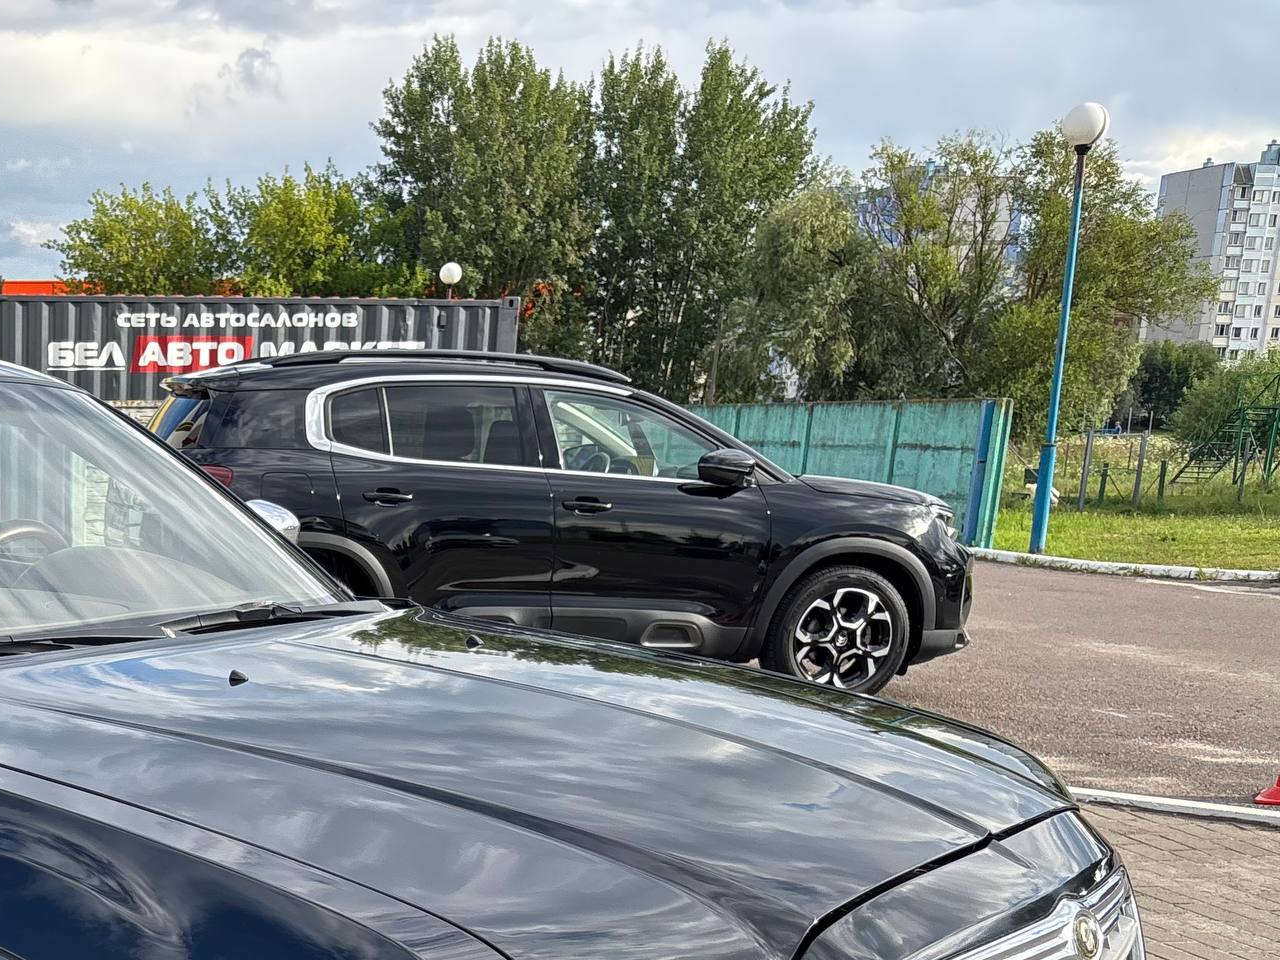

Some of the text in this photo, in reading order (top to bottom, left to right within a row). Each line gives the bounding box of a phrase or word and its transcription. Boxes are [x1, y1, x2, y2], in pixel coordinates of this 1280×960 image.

[116, 312, 359, 329] СЕТЬ АВТОСАЛОНОВ
[47, 341, 125, 367] БЕЛ
[138, 341, 245, 367] АВТО
